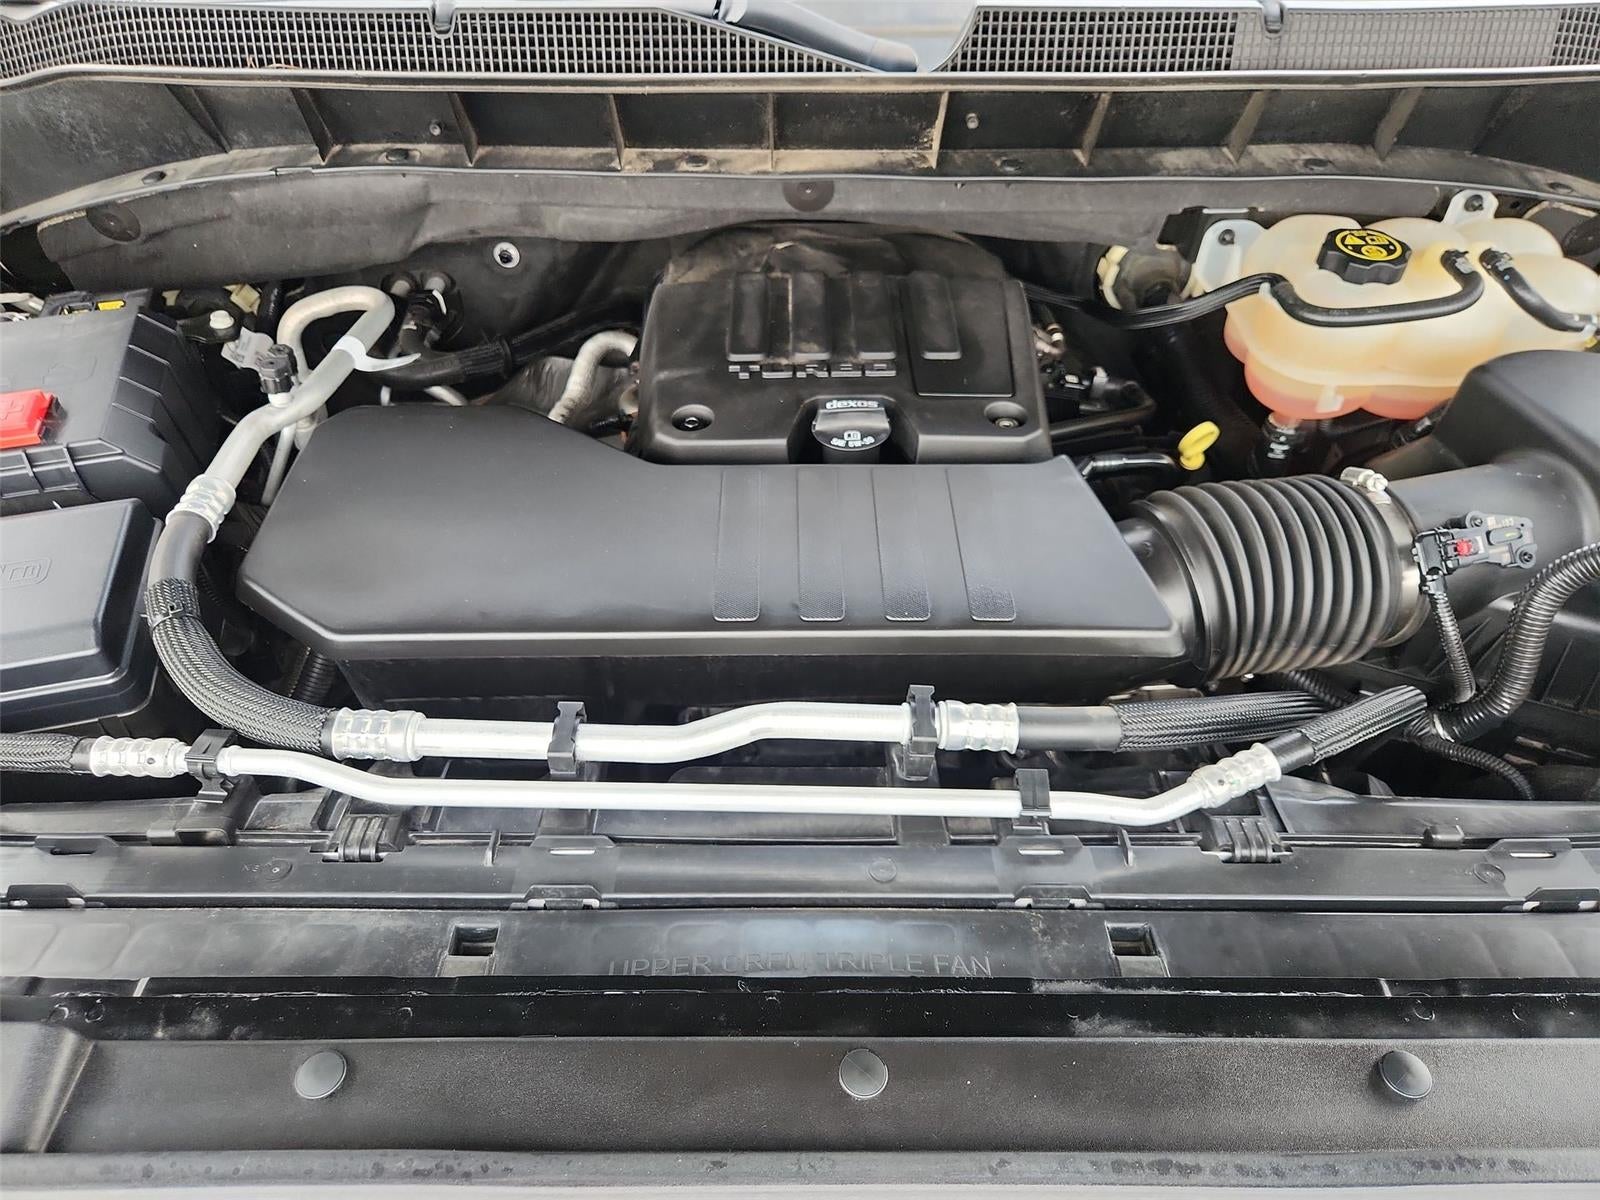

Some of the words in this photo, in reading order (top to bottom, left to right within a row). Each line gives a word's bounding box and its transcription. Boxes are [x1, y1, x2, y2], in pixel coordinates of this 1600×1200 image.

[826, 400, 879, 409] dexos
[608, 954, 712, 976] UPPER
[816, 952, 925, 974] TRIPLE
[932, 952, 992, 976] FAN
